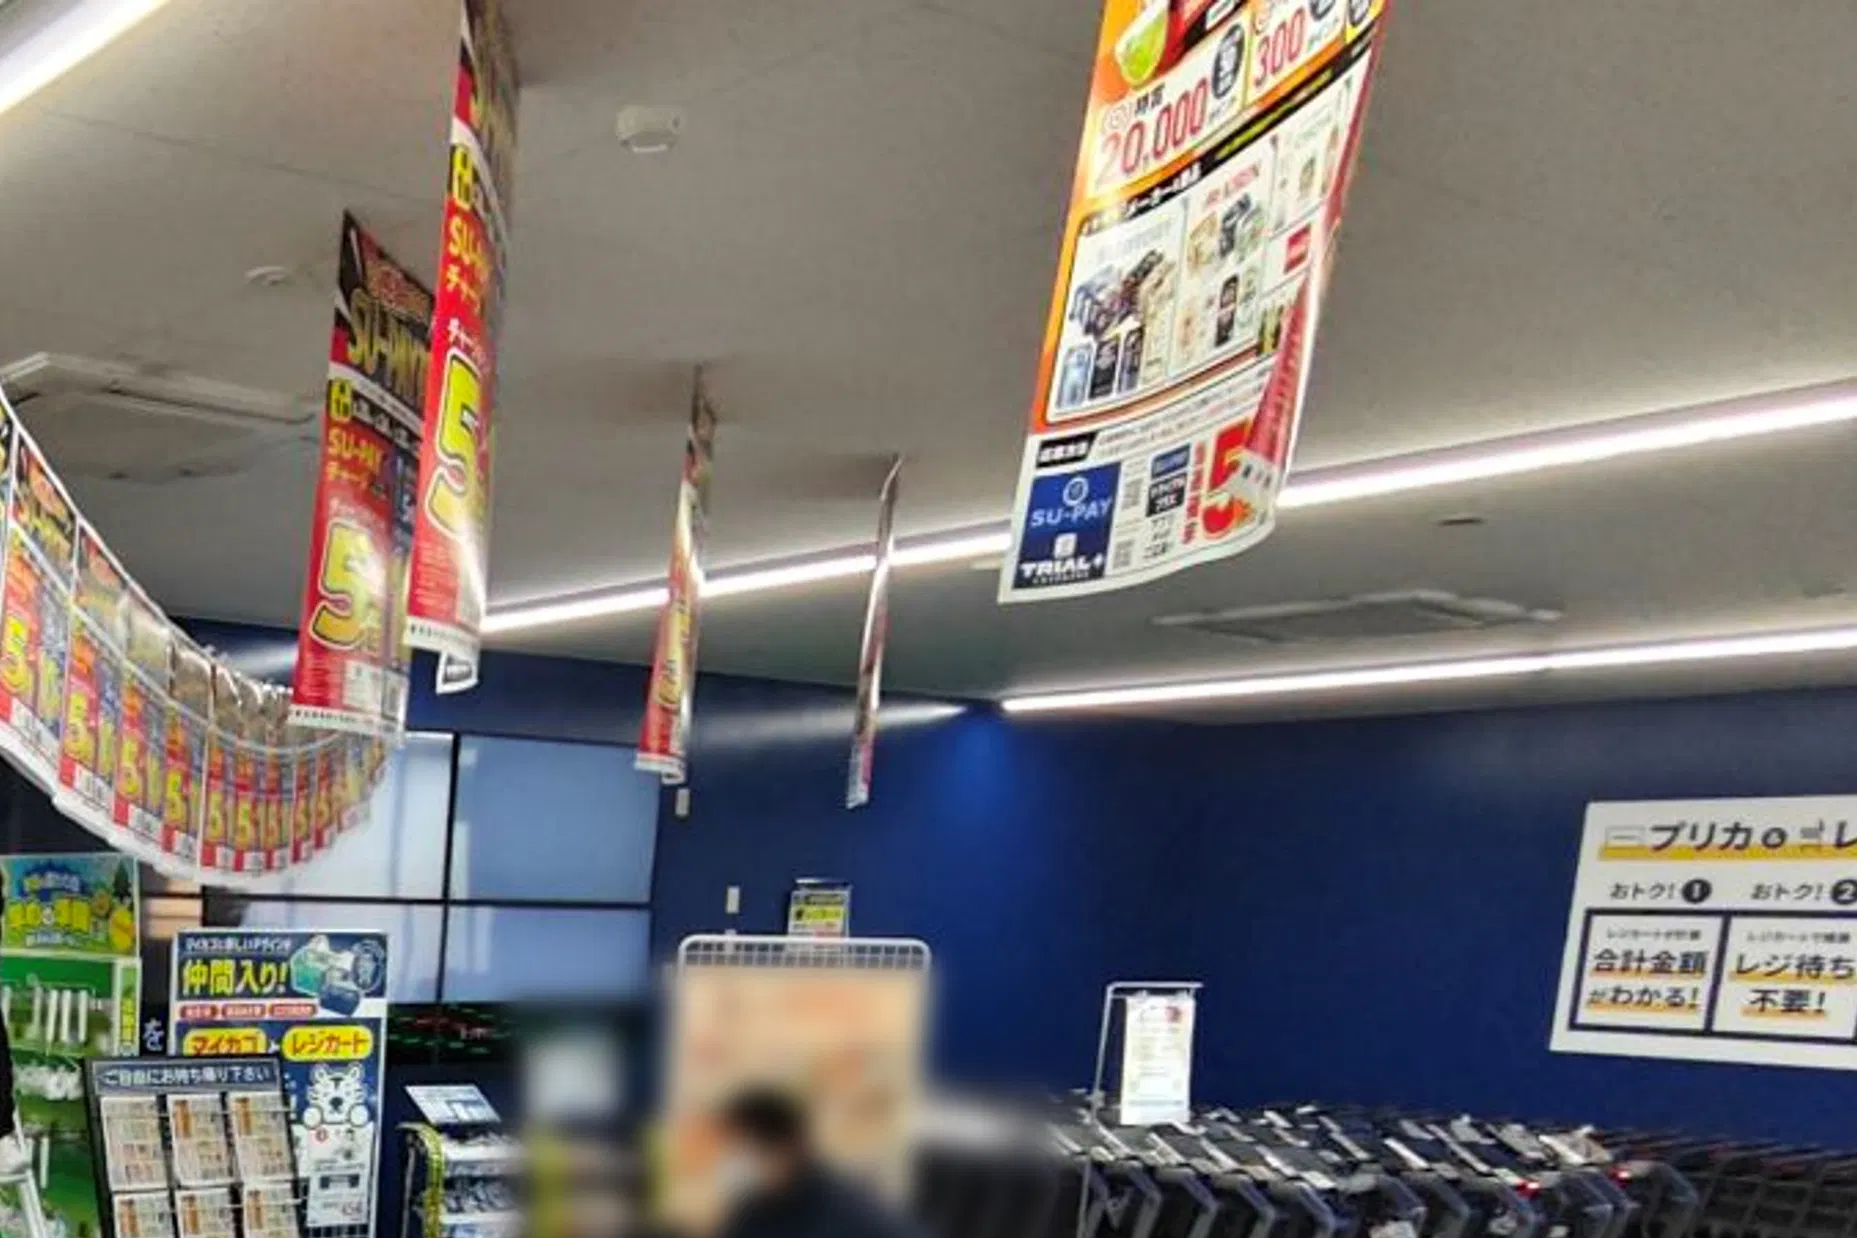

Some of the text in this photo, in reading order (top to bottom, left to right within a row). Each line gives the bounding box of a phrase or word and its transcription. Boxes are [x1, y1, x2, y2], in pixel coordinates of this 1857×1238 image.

[1030, 497, 1112, 527] SU-PAY
[1594, 948, 1709, 975] 合計金額
[1736, 954, 1857, 981] レジ待ち
[182, 958, 288, 997] 仲間入り!
[1750, 988, 1826, 1013] 不要!
[292, 1029, 370, 1055] レジカート
